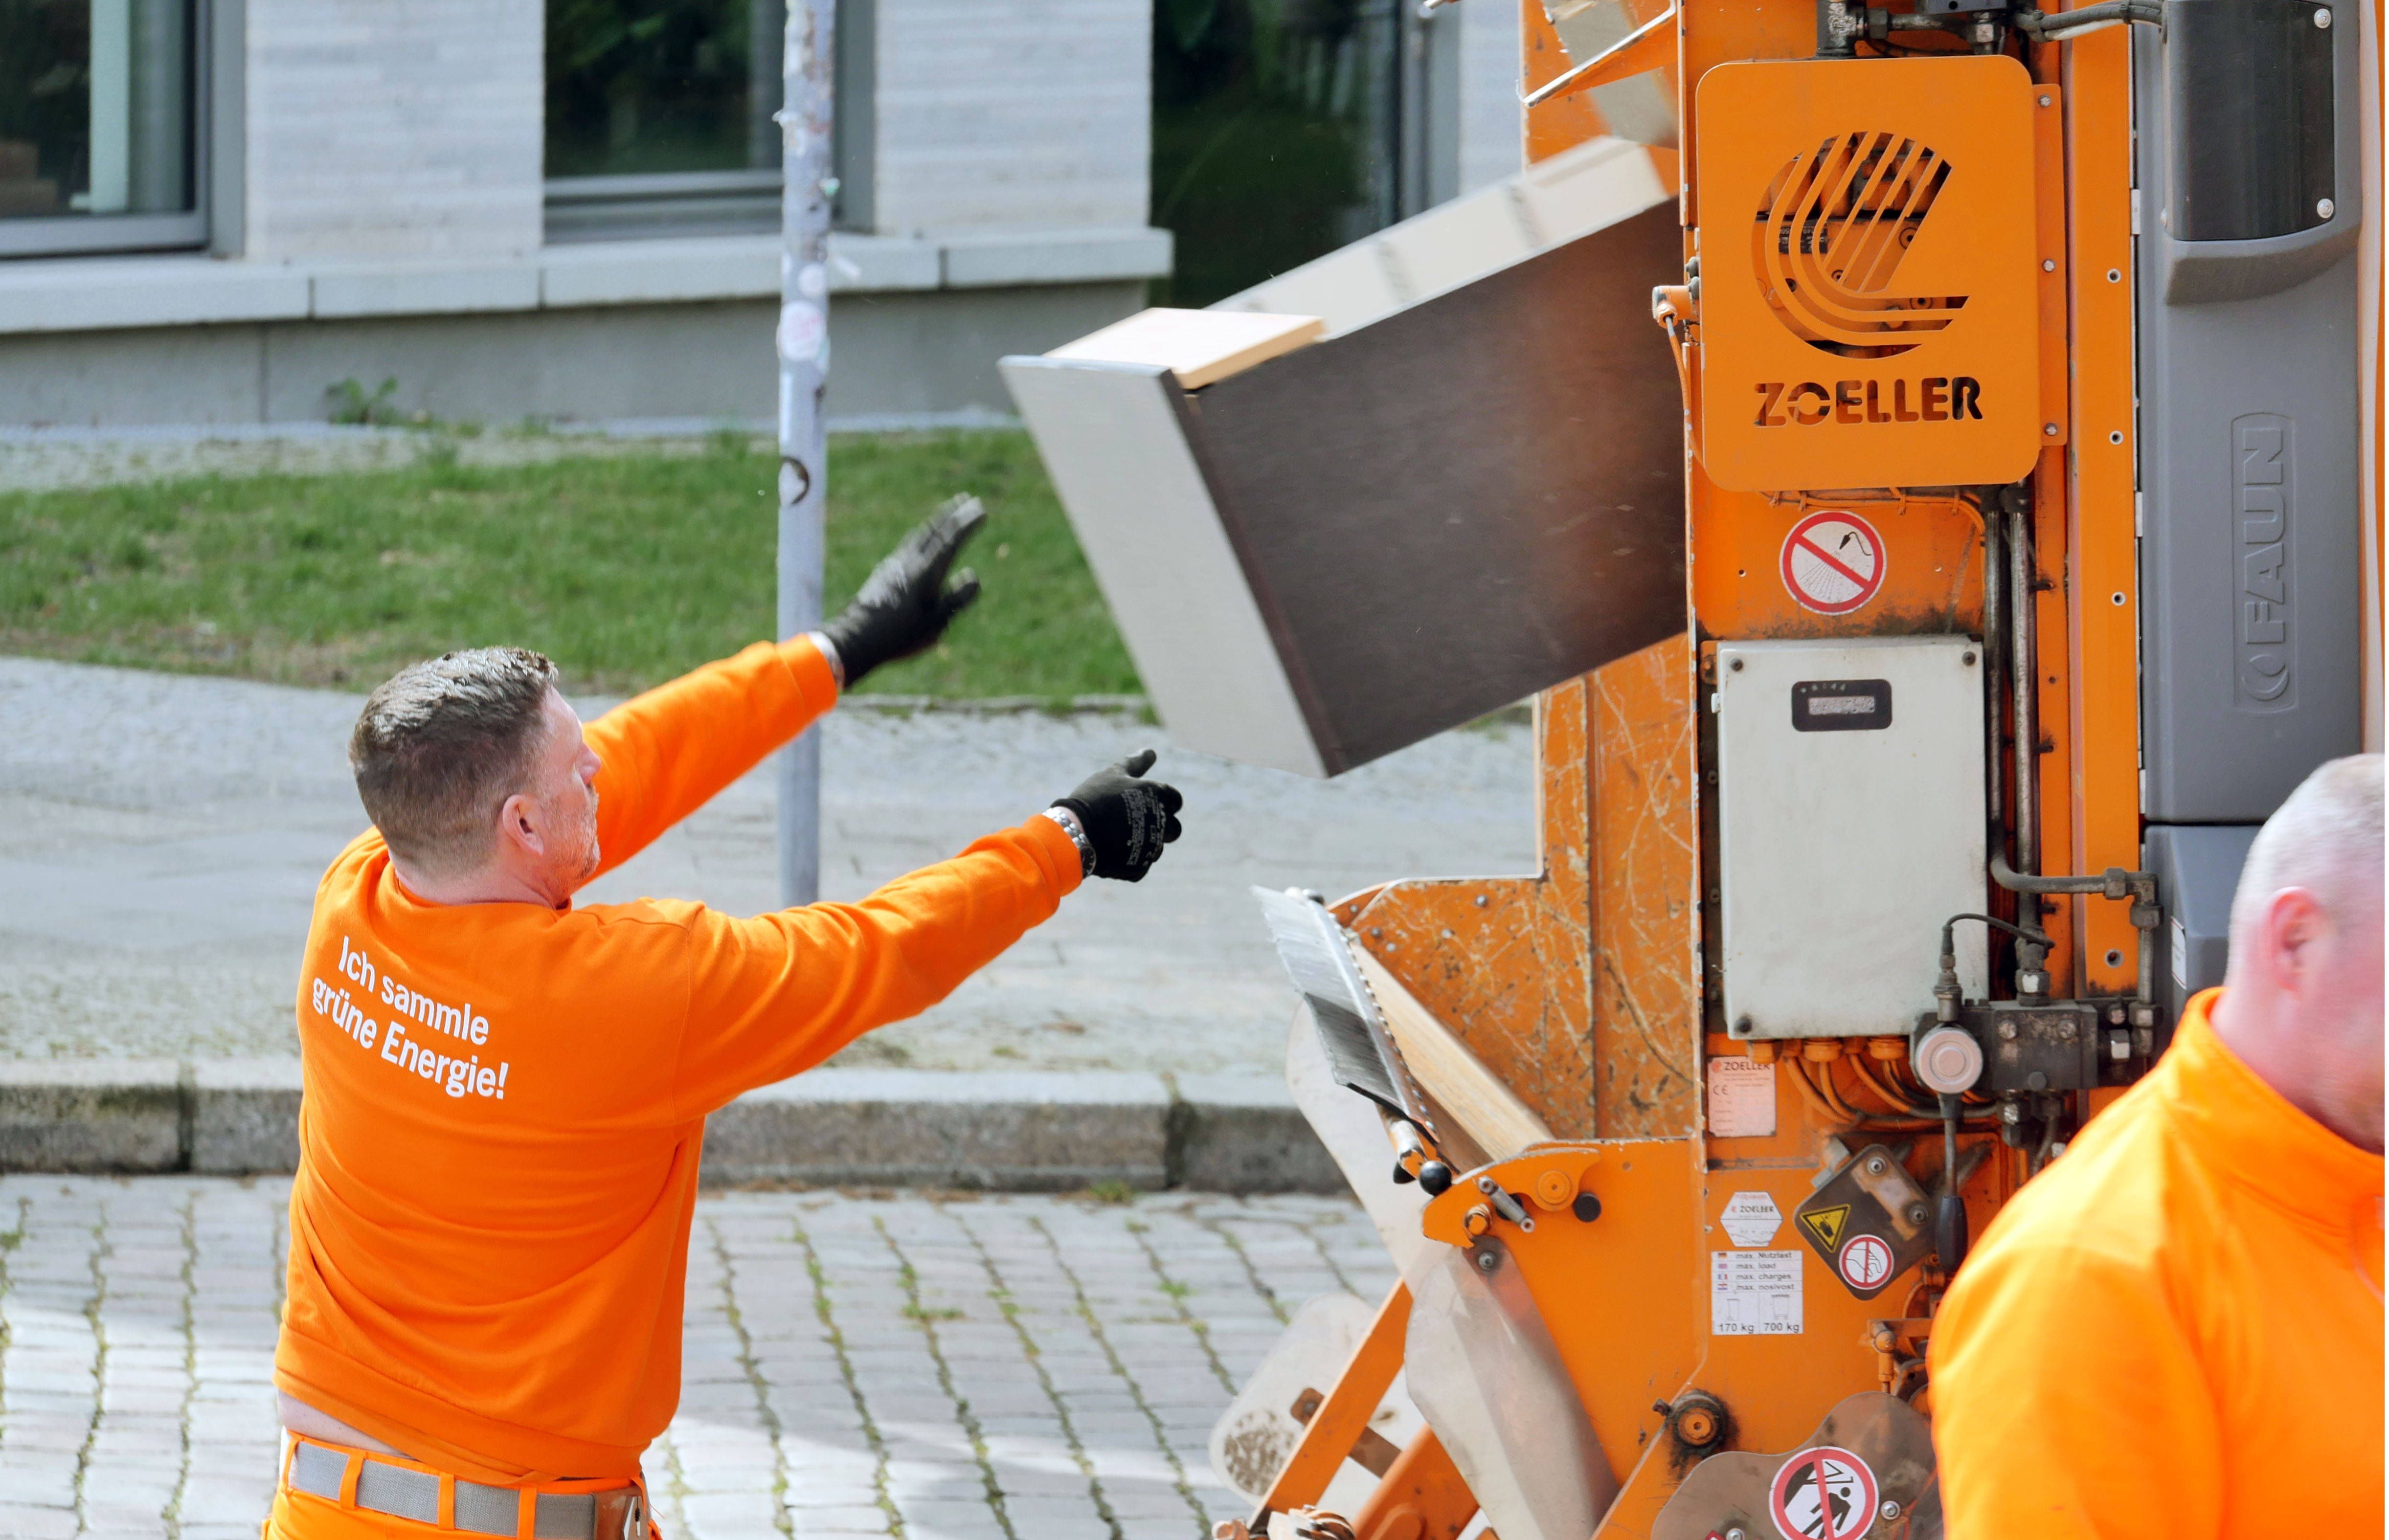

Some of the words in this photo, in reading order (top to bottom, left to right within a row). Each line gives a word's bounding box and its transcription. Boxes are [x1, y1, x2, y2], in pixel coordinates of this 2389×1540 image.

[1753, 376, 1983, 427] ZOELLER
[2243, 426, 2286, 645] FAUN
[338, 935, 375, 993] Ich
[381, 975, 489, 1046] sammle
[312, 978, 377, 1049] grüne
[381, 1020, 509, 1100] Energie!
[1758, 1272, 1791, 1281] charges
[1718, 1323, 1737, 1332] 170
[1741, 1323, 1755, 1334] kg
[1764, 1322, 1782, 1331] 700
[1787, 1322, 1800, 1333] kg
